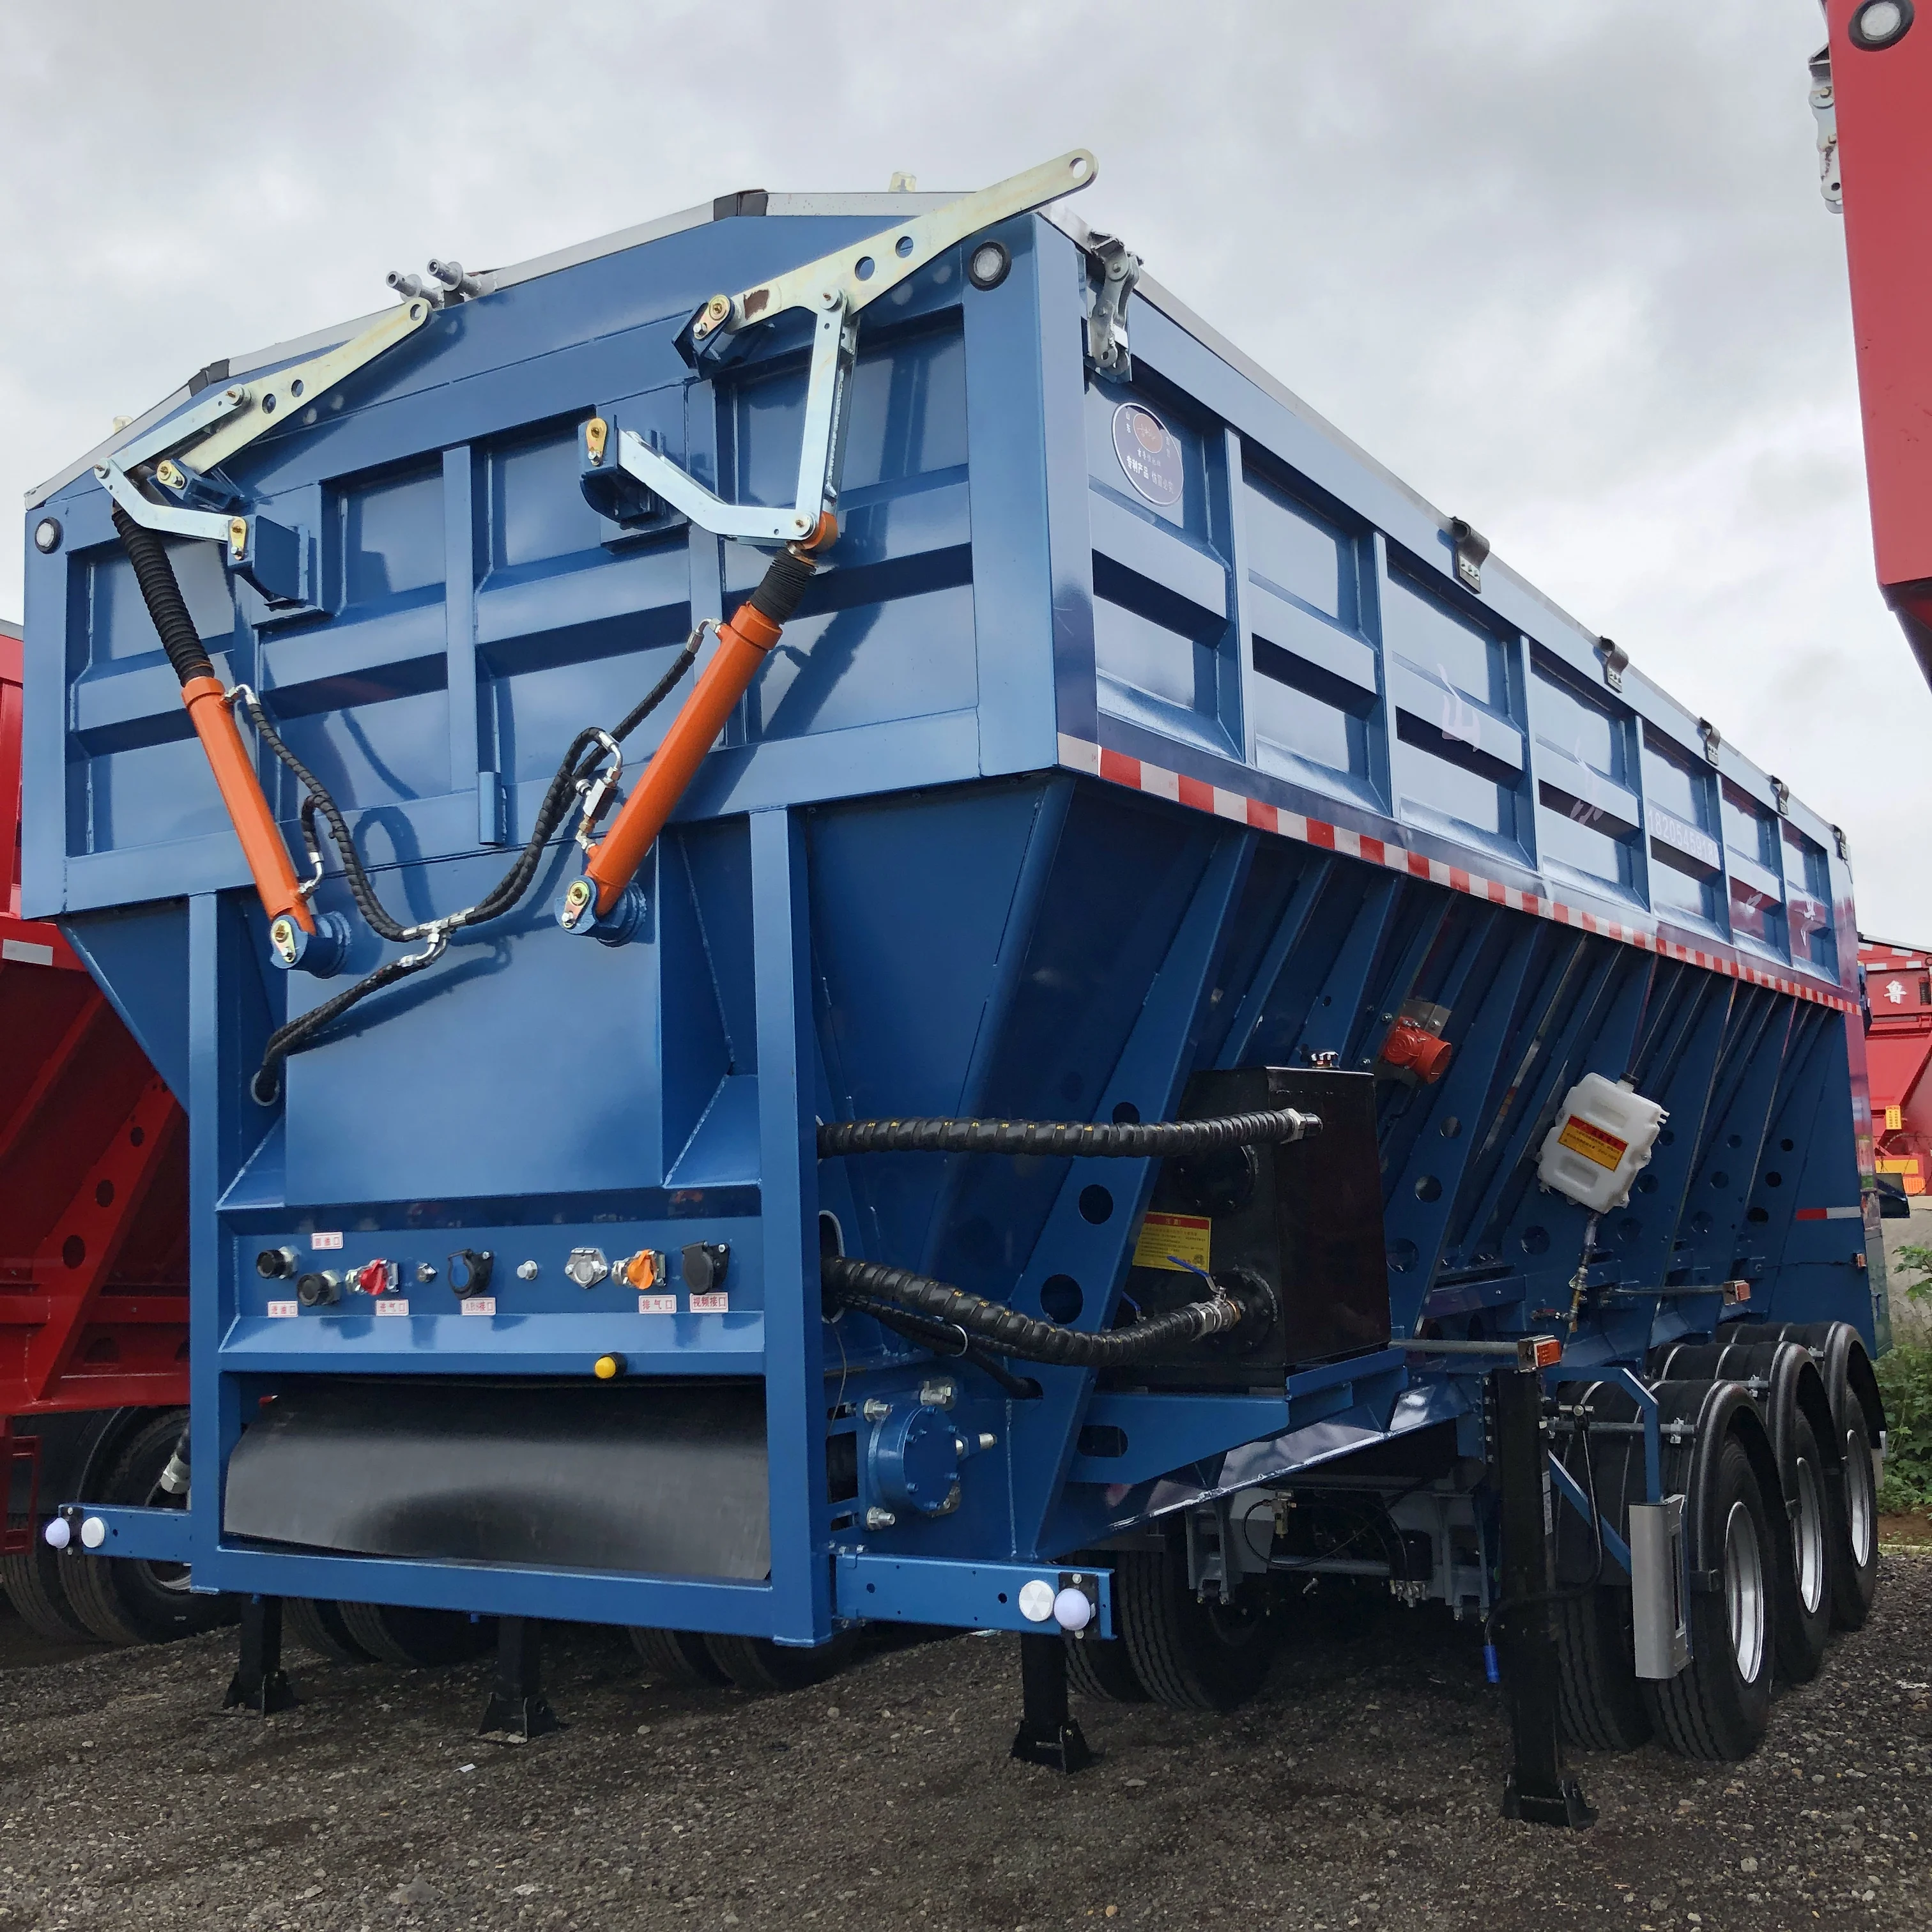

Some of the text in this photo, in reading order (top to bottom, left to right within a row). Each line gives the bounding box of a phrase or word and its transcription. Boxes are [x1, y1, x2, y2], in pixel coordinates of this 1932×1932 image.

[1125, 454, 1150, 480] 专利产品
[1883, 979, 1907, 1005] 鲁
[642, 1298, 673, 1310] 排气口
[693, 1296, 726, 1307] 视频接口
